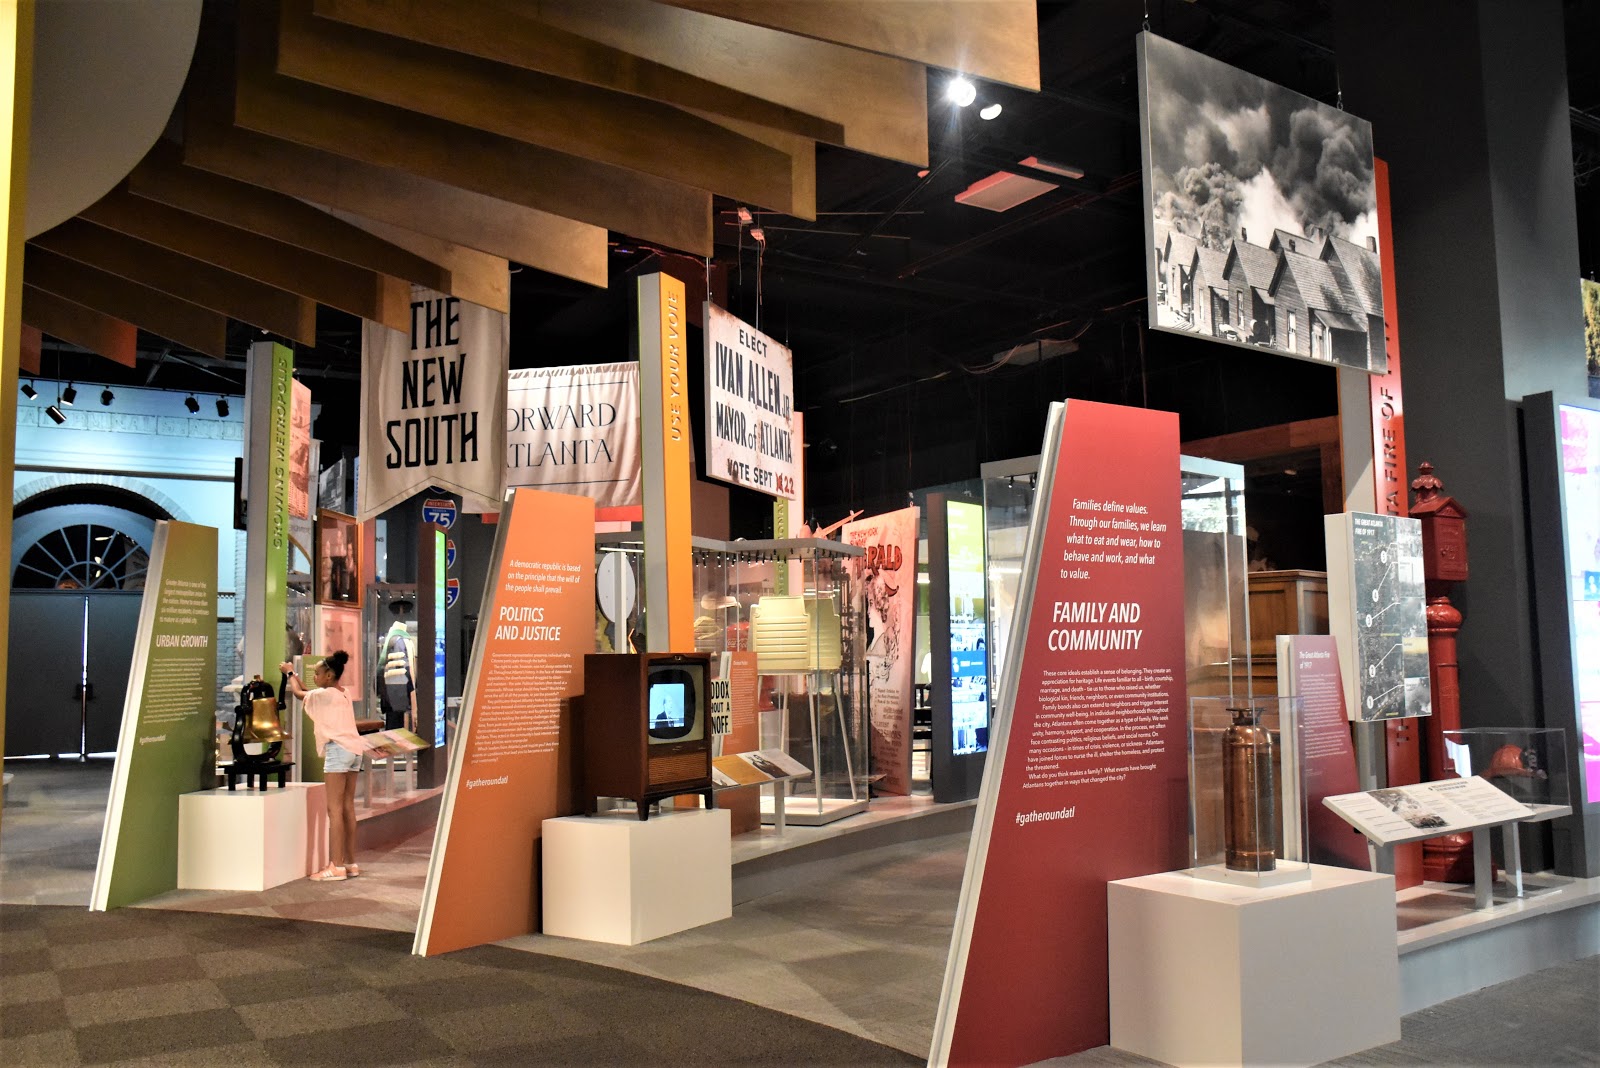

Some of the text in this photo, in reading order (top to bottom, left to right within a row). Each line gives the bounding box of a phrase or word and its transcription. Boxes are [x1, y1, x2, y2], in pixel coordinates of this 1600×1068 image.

[410, 297, 460, 350] THE
[740, 329, 767, 358] ELECT
[668, 291, 681, 441] USE YOUR VOTE
[401, 353, 466, 410] NEW
[716, 341, 743, 398] IVAN
[748, 360, 781, 416] ALLEN
[1381, 387, 1394, 420] OF
[386, 412, 478, 469] SOUTH
[716, 401, 792, 464] MAYOR of ATLANTA
[274, 358, 287, 549] GROWING METROPOLIS
[507, 438, 614, 468] TLANTA
[1383, 428, 1398, 482] FIRE
[728, 458, 750, 481] VOTE
[754, 467, 772, 488] SEPT
[785, 476, 794, 494] 22
[1073, 499, 1148, 514] Families define values.
[429, 512, 450, 527] 75
[1070, 516, 1098, 530] Through
[1112, 518, 1138, 531] families,
[1151, 520, 1166, 531] learn
[1067, 533, 1084, 544] what
[1094, 534, 1104, 545] eat
[1106, 535, 1118, 546] and
[1120, 539, 1137, 548] wear,
[1139, 537, 1152, 547] how
[514, 560, 541, 568] democratic
[542, 563, 561, 572] republic
[1064, 551, 1155, 565] behave and work, and what
[525, 574, 546, 583] principle
[1070, 569, 1090, 579] value.
[515, 584, 532, 593] people
[545, 586, 562, 595] prevail.
[500, 606, 544, 622] POLITICS
[1053, 602, 1140, 623] FAMILY AND
[156, 635, 208, 647] URBAN GROWTH
[495, 626, 561, 640] AND JUSTICE
[1048, 630, 1142, 651] COMMUNITY
[1016, 806, 1075, 826] #gatheroundatl
